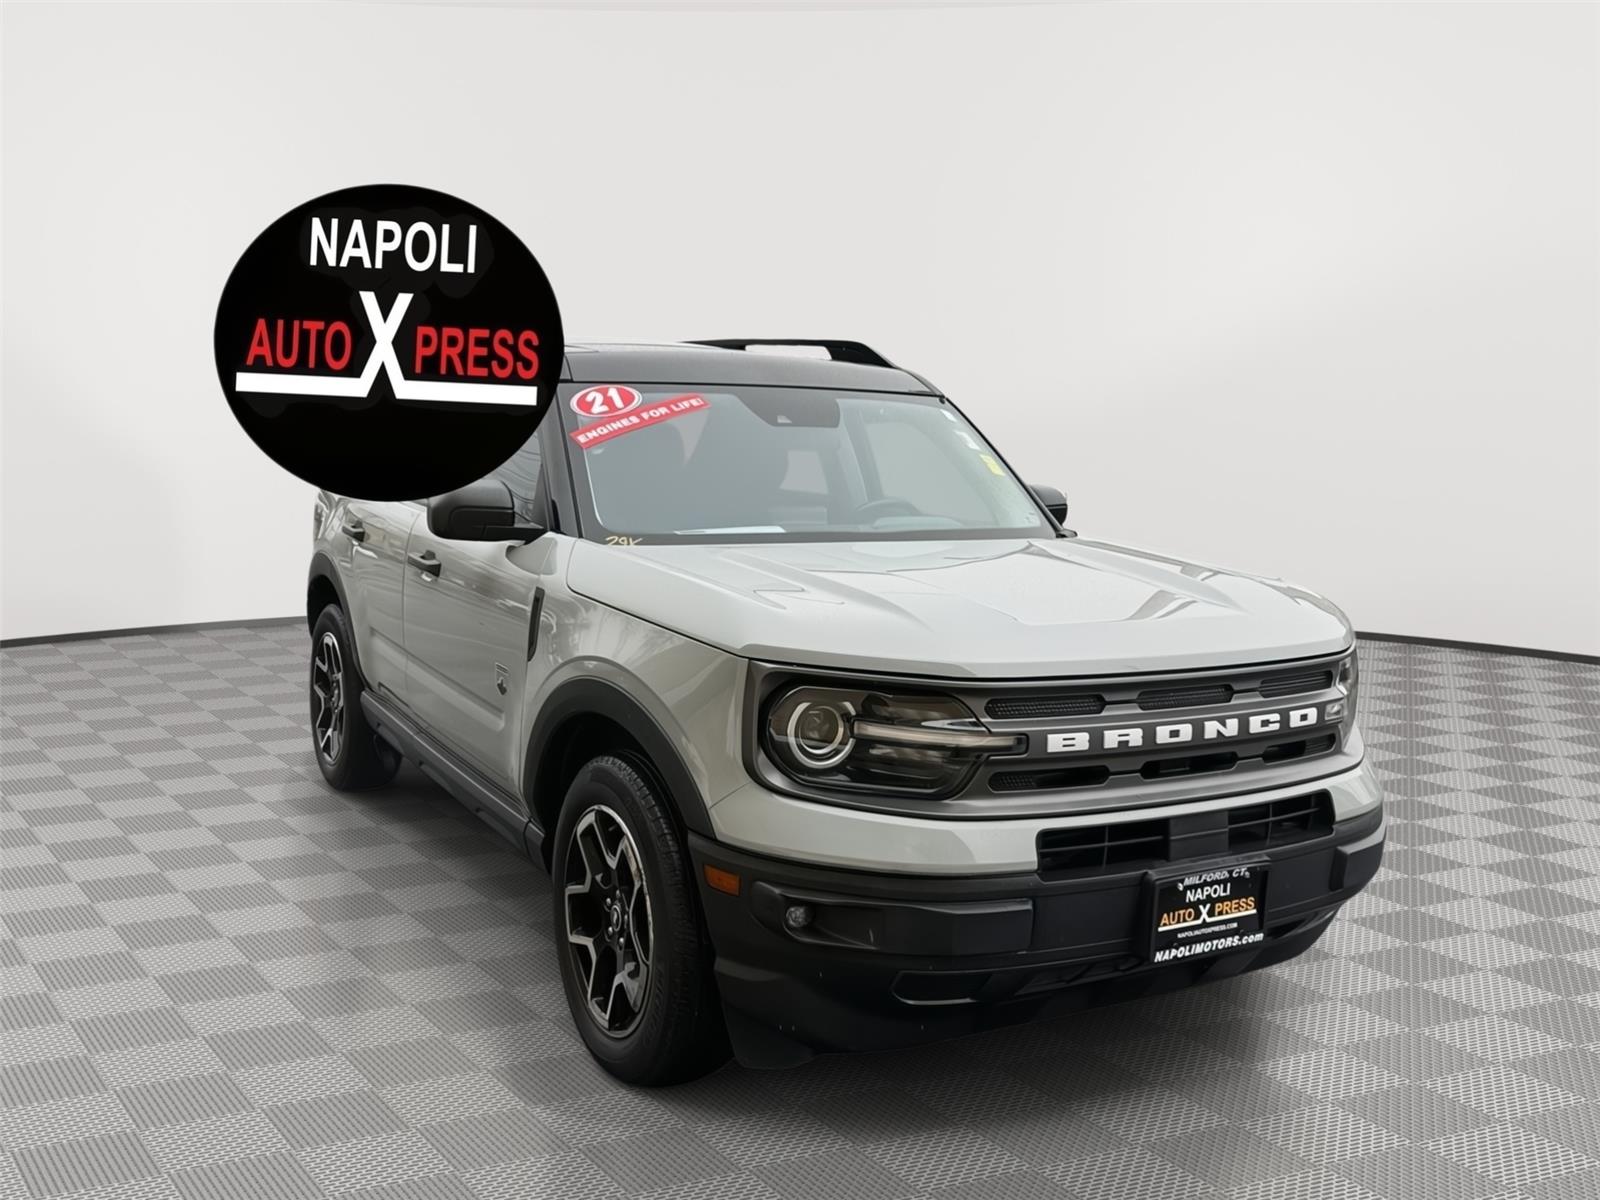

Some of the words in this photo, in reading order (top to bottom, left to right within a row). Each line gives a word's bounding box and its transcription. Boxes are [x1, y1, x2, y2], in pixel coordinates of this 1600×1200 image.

[585, 387, 624, 414] 21
[577, 415, 640, 443] ENGINES
[641, 404, 670, 421] FOR
[671, 398, 705, 412] LIFE!
[1047, 707, 1318, 752] BRONCO
[1185, 882, 1231, 903] NAPOLI
[1154, 933, 1264, 963] NAPOLIMOTORS.com
